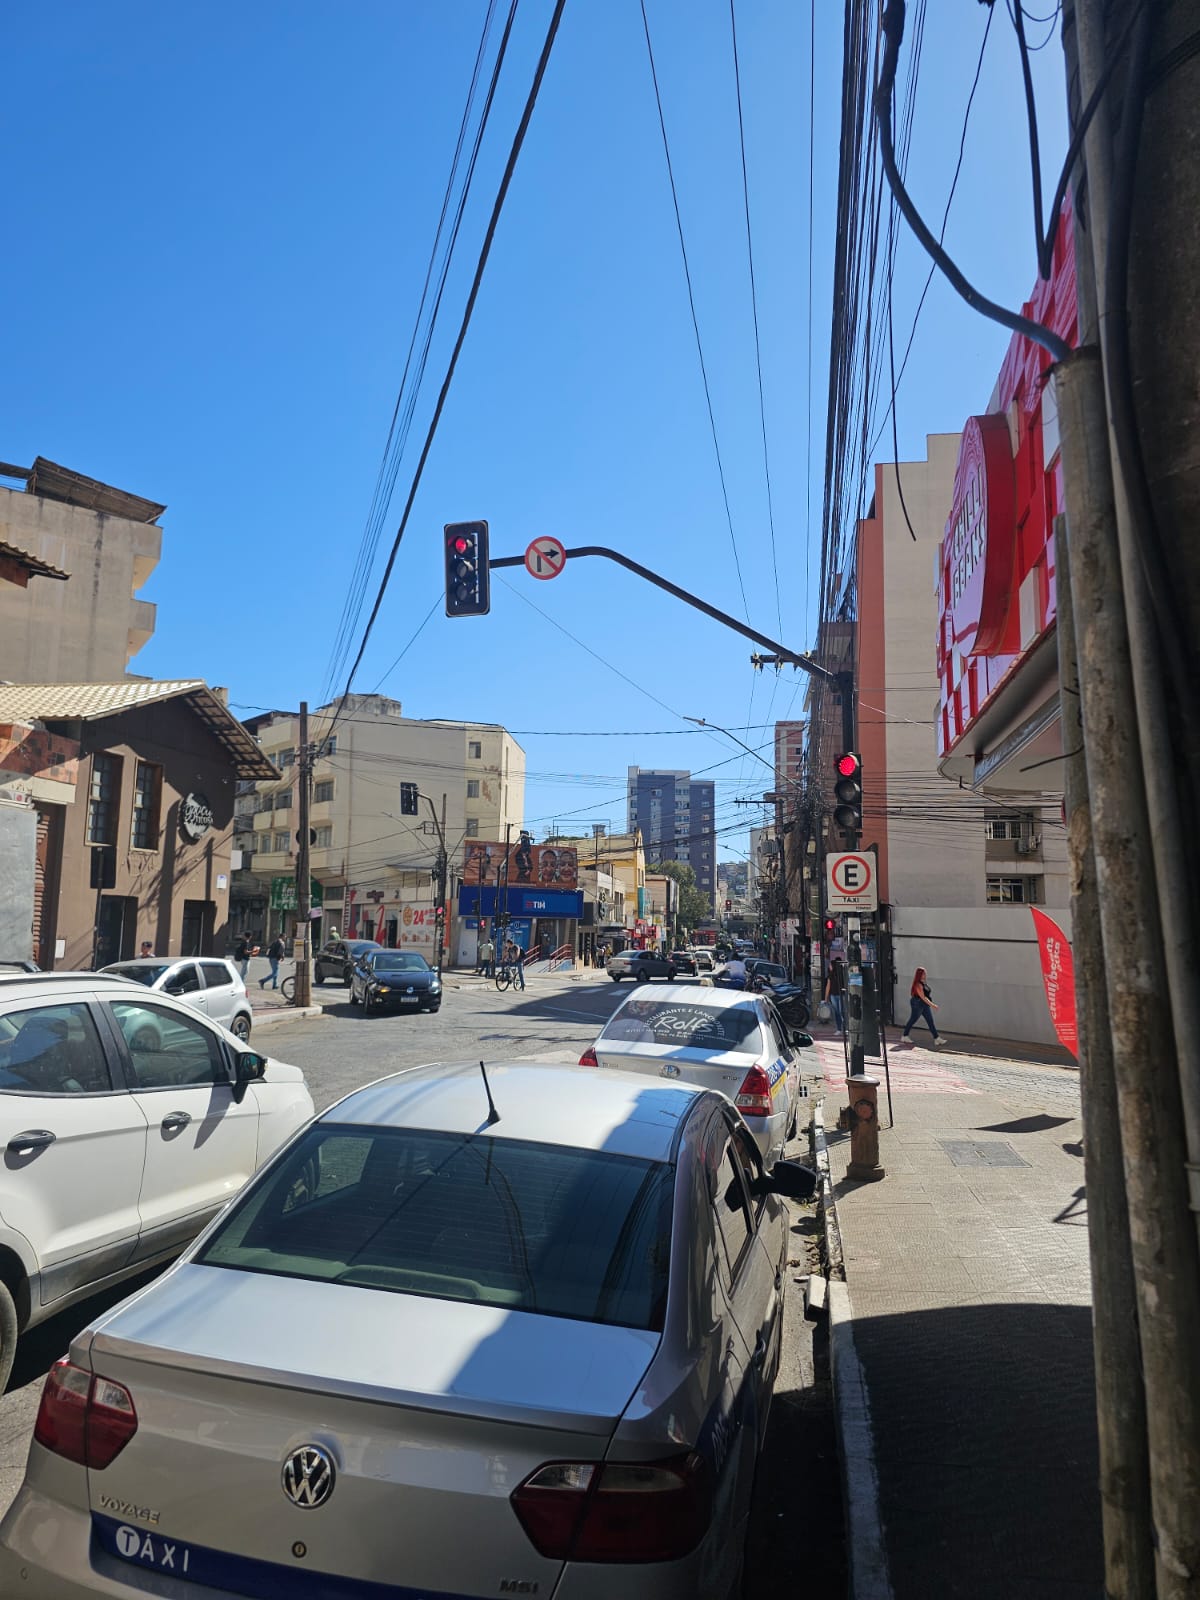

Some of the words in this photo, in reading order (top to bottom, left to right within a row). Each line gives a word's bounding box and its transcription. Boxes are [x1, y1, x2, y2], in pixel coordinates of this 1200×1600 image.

[844, 864, 858, 886] E
[413, 910, 425, 925] 24
[654, 1015, 715, 1033] Rolfs
[100, 1494, 160, 1525] VOYAGE
